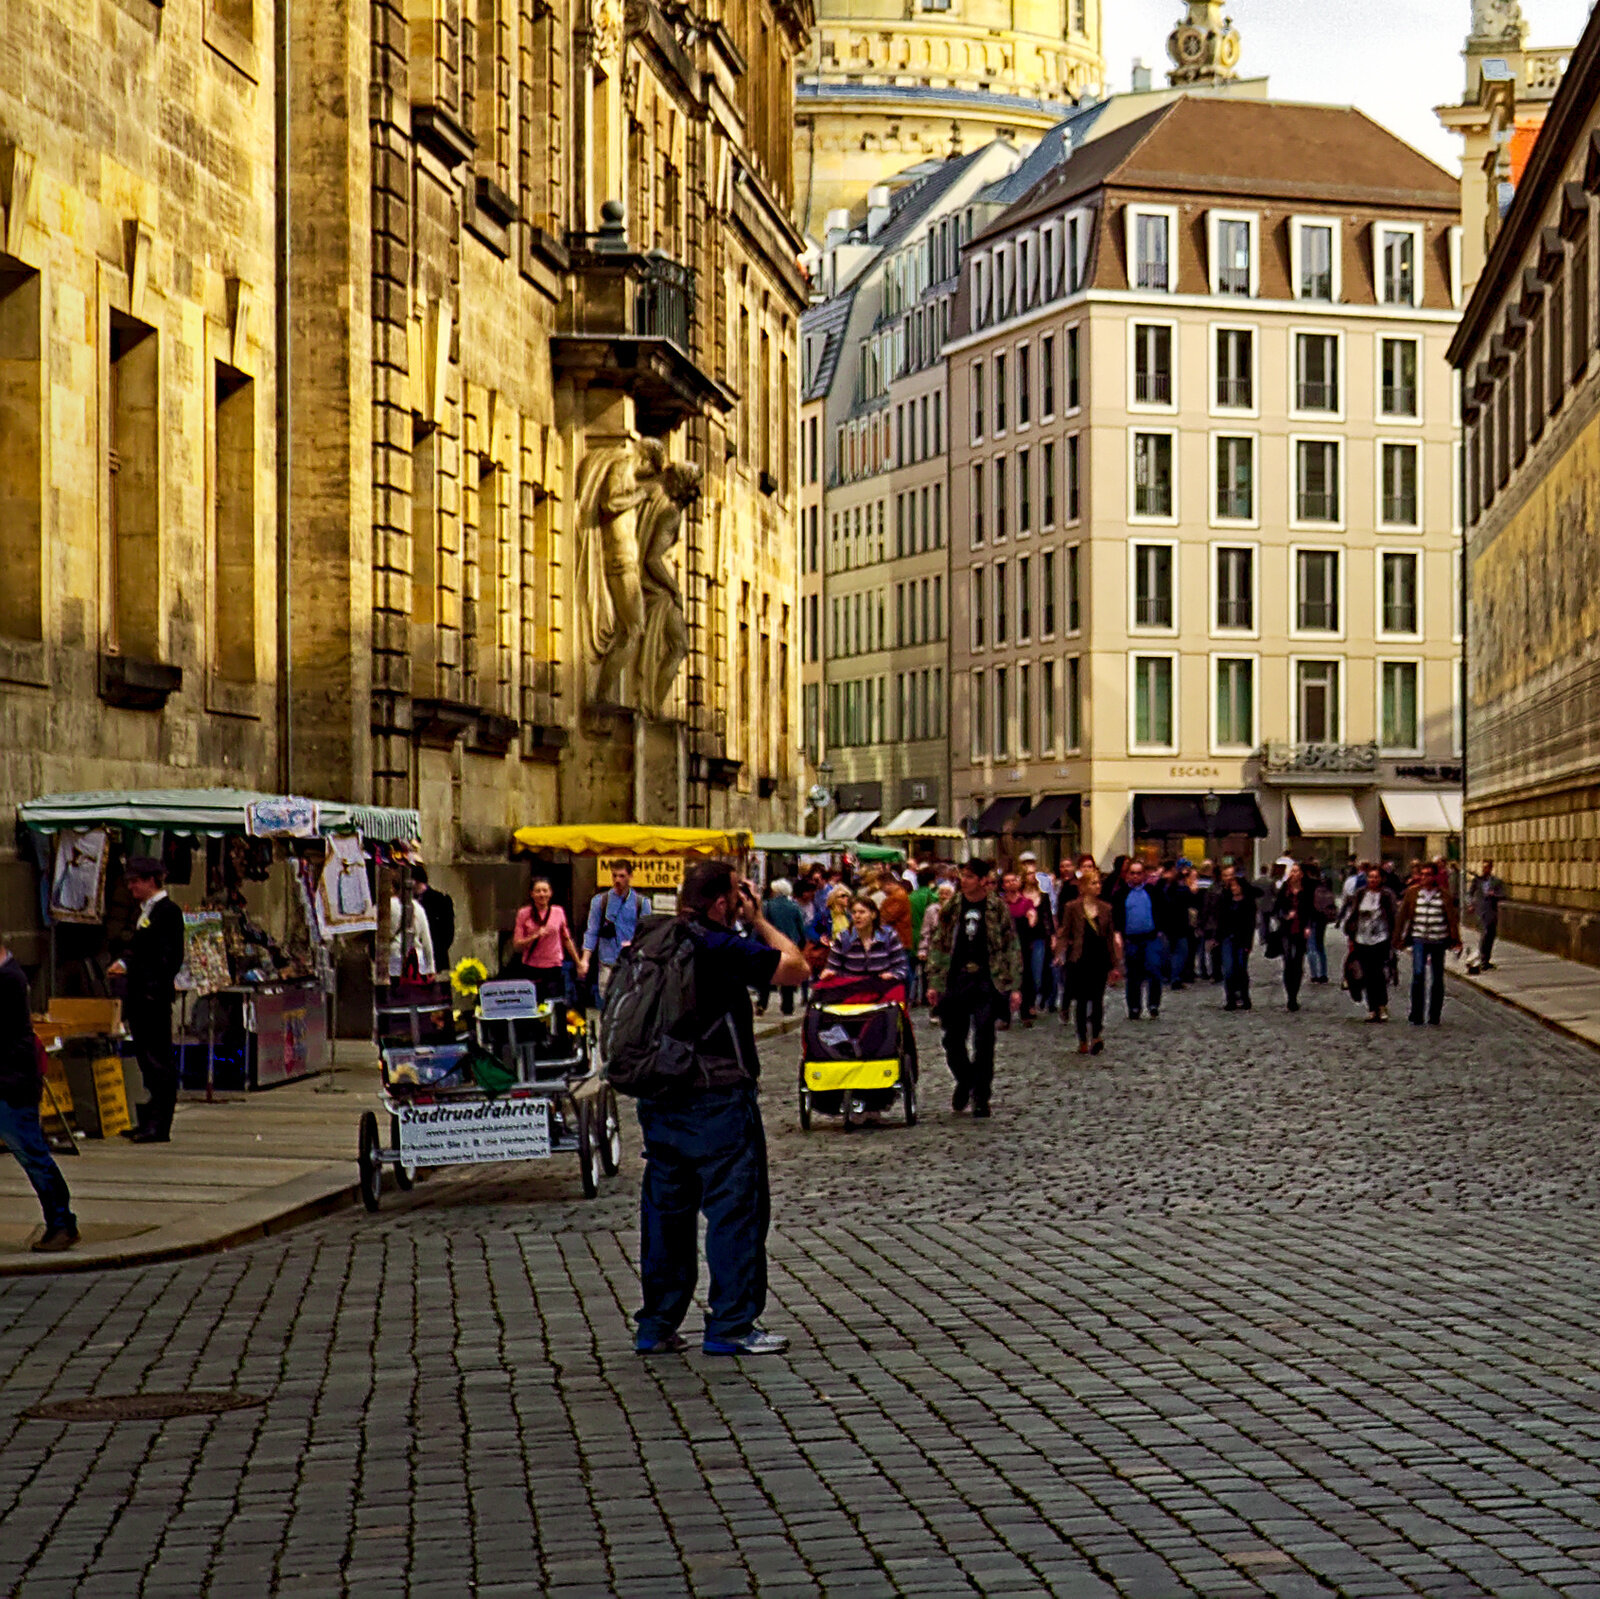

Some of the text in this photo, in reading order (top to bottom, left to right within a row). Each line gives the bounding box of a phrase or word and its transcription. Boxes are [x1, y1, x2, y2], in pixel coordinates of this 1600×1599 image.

[1170, 766, 1219, 777] ESCADA
[673, 874, 681, 884] €
[401, 1100, 546, 1124] Stadtrundfahrten
